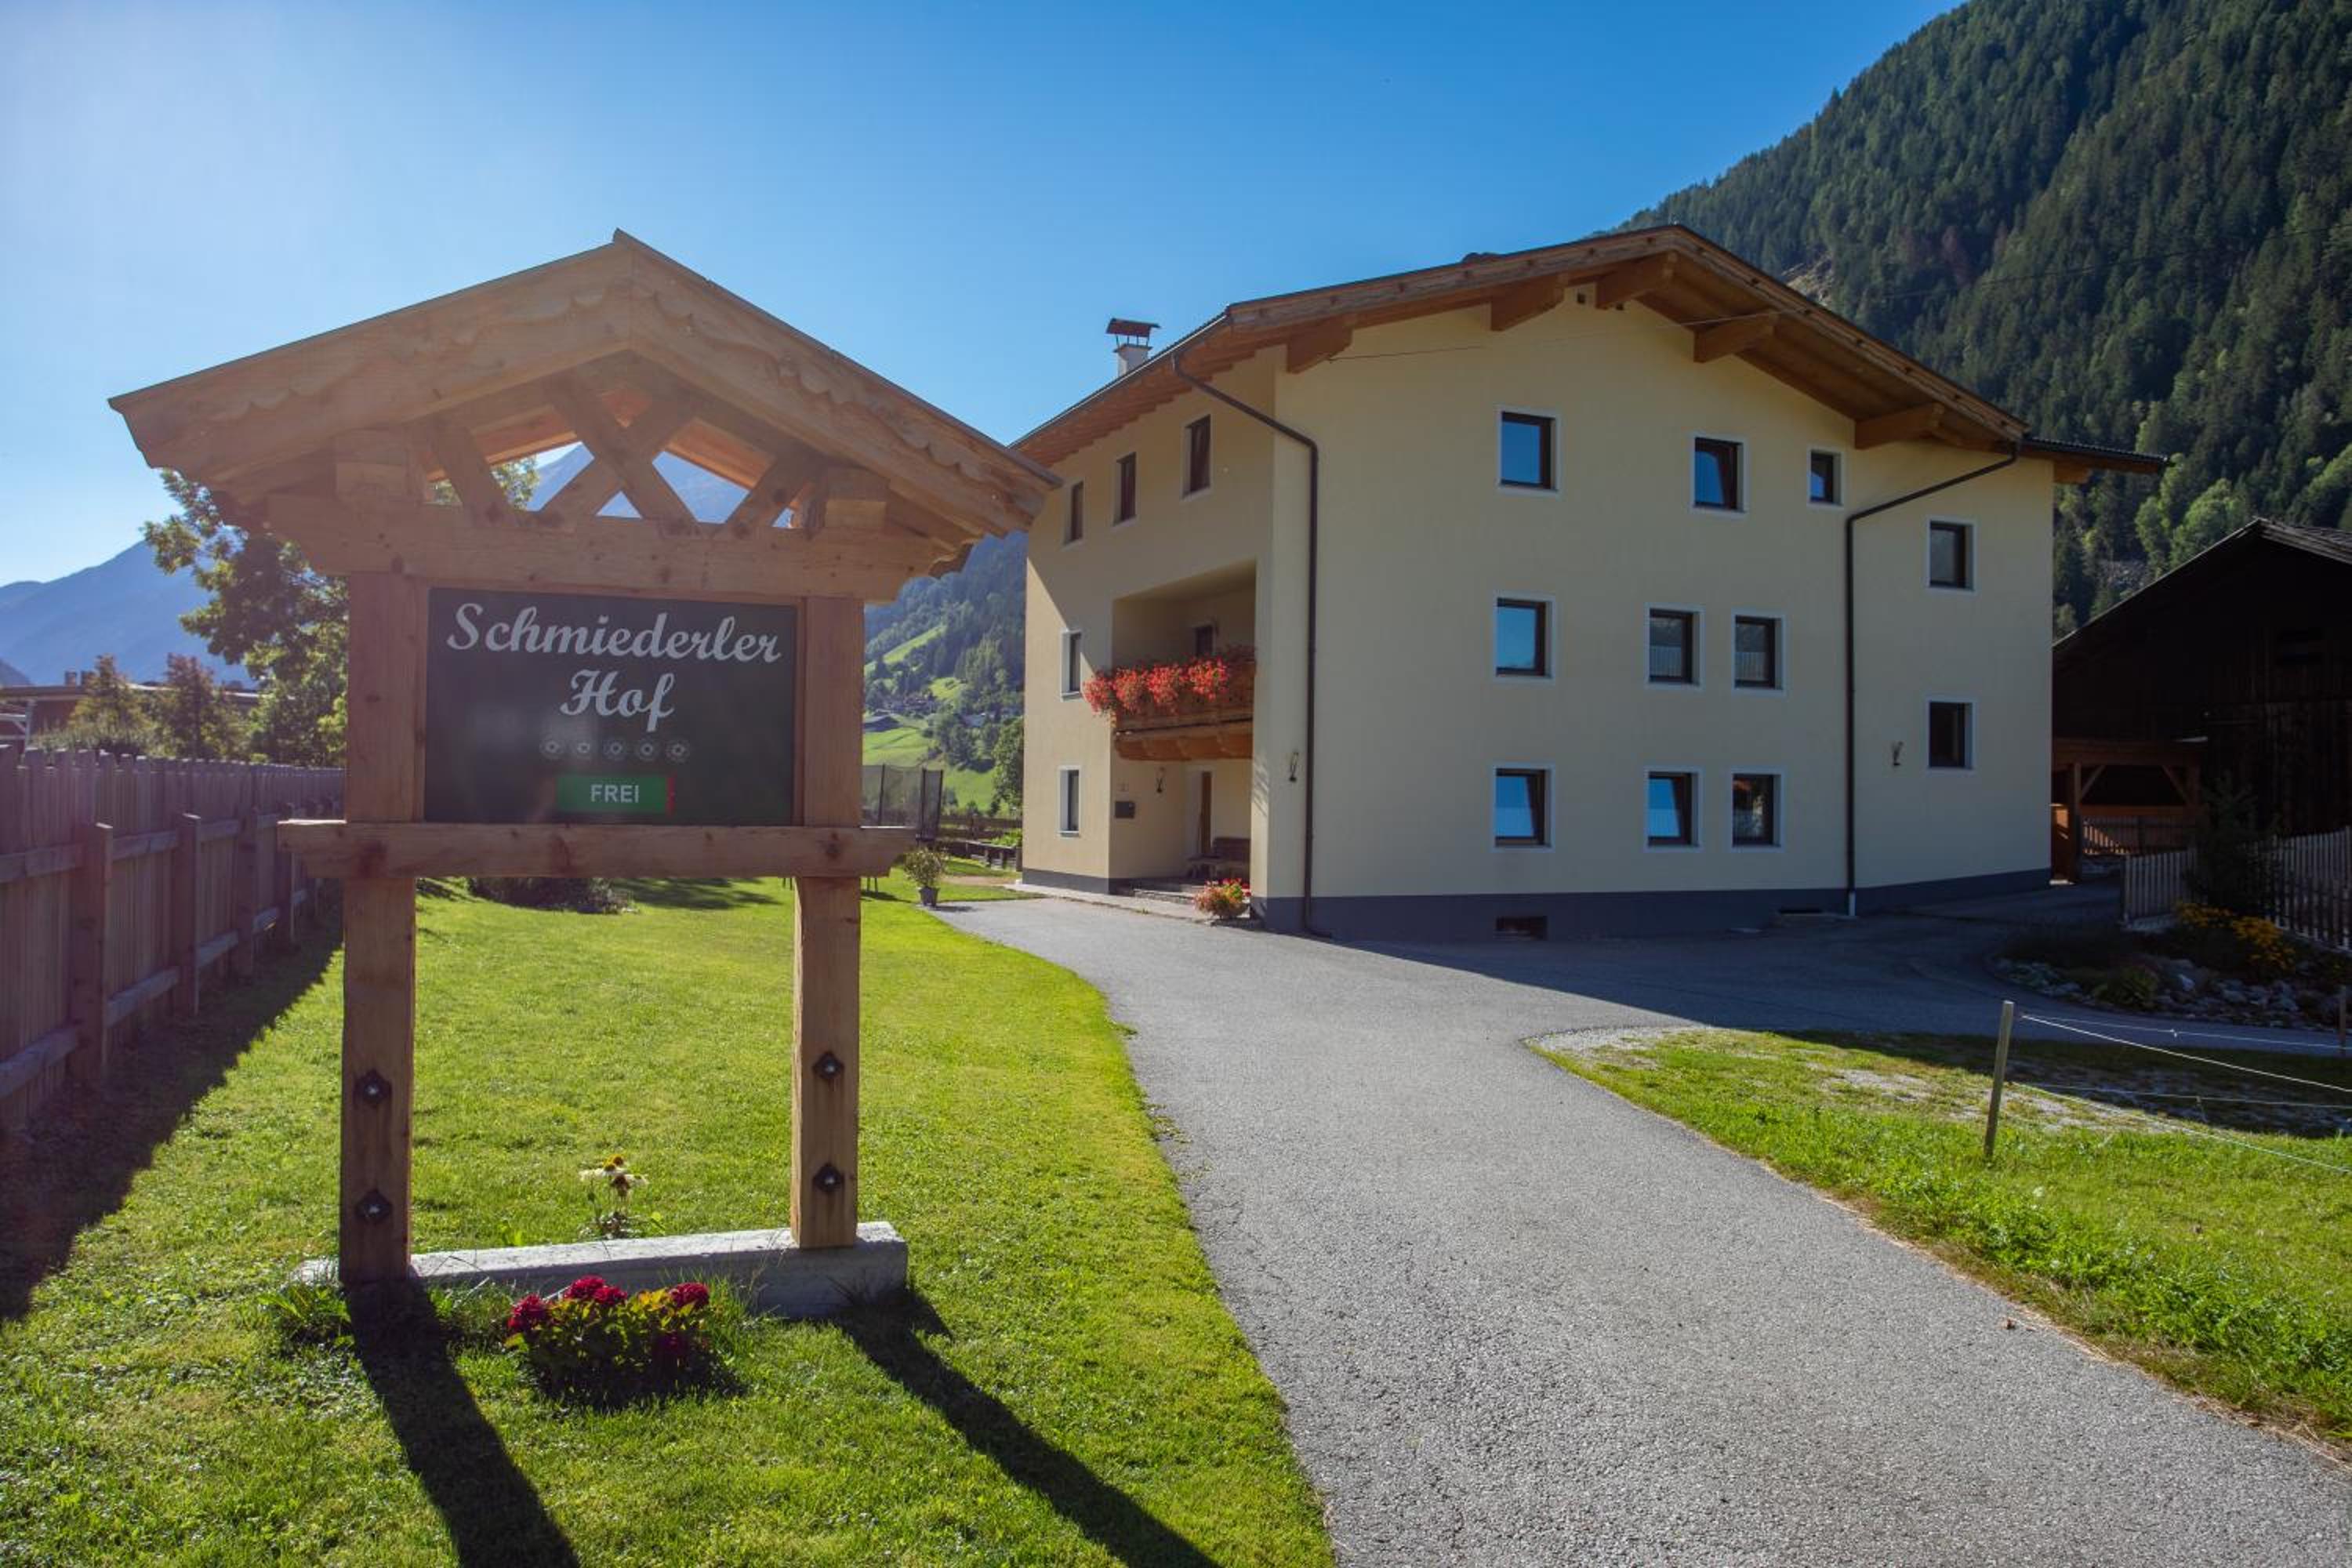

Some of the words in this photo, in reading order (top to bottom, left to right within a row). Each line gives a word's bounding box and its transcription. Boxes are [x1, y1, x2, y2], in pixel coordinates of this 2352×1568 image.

[447, 603, 781, 663] Schmiederler
[560, 669, 676, 732] Hof
[590, 784, 640, 804] FREI
